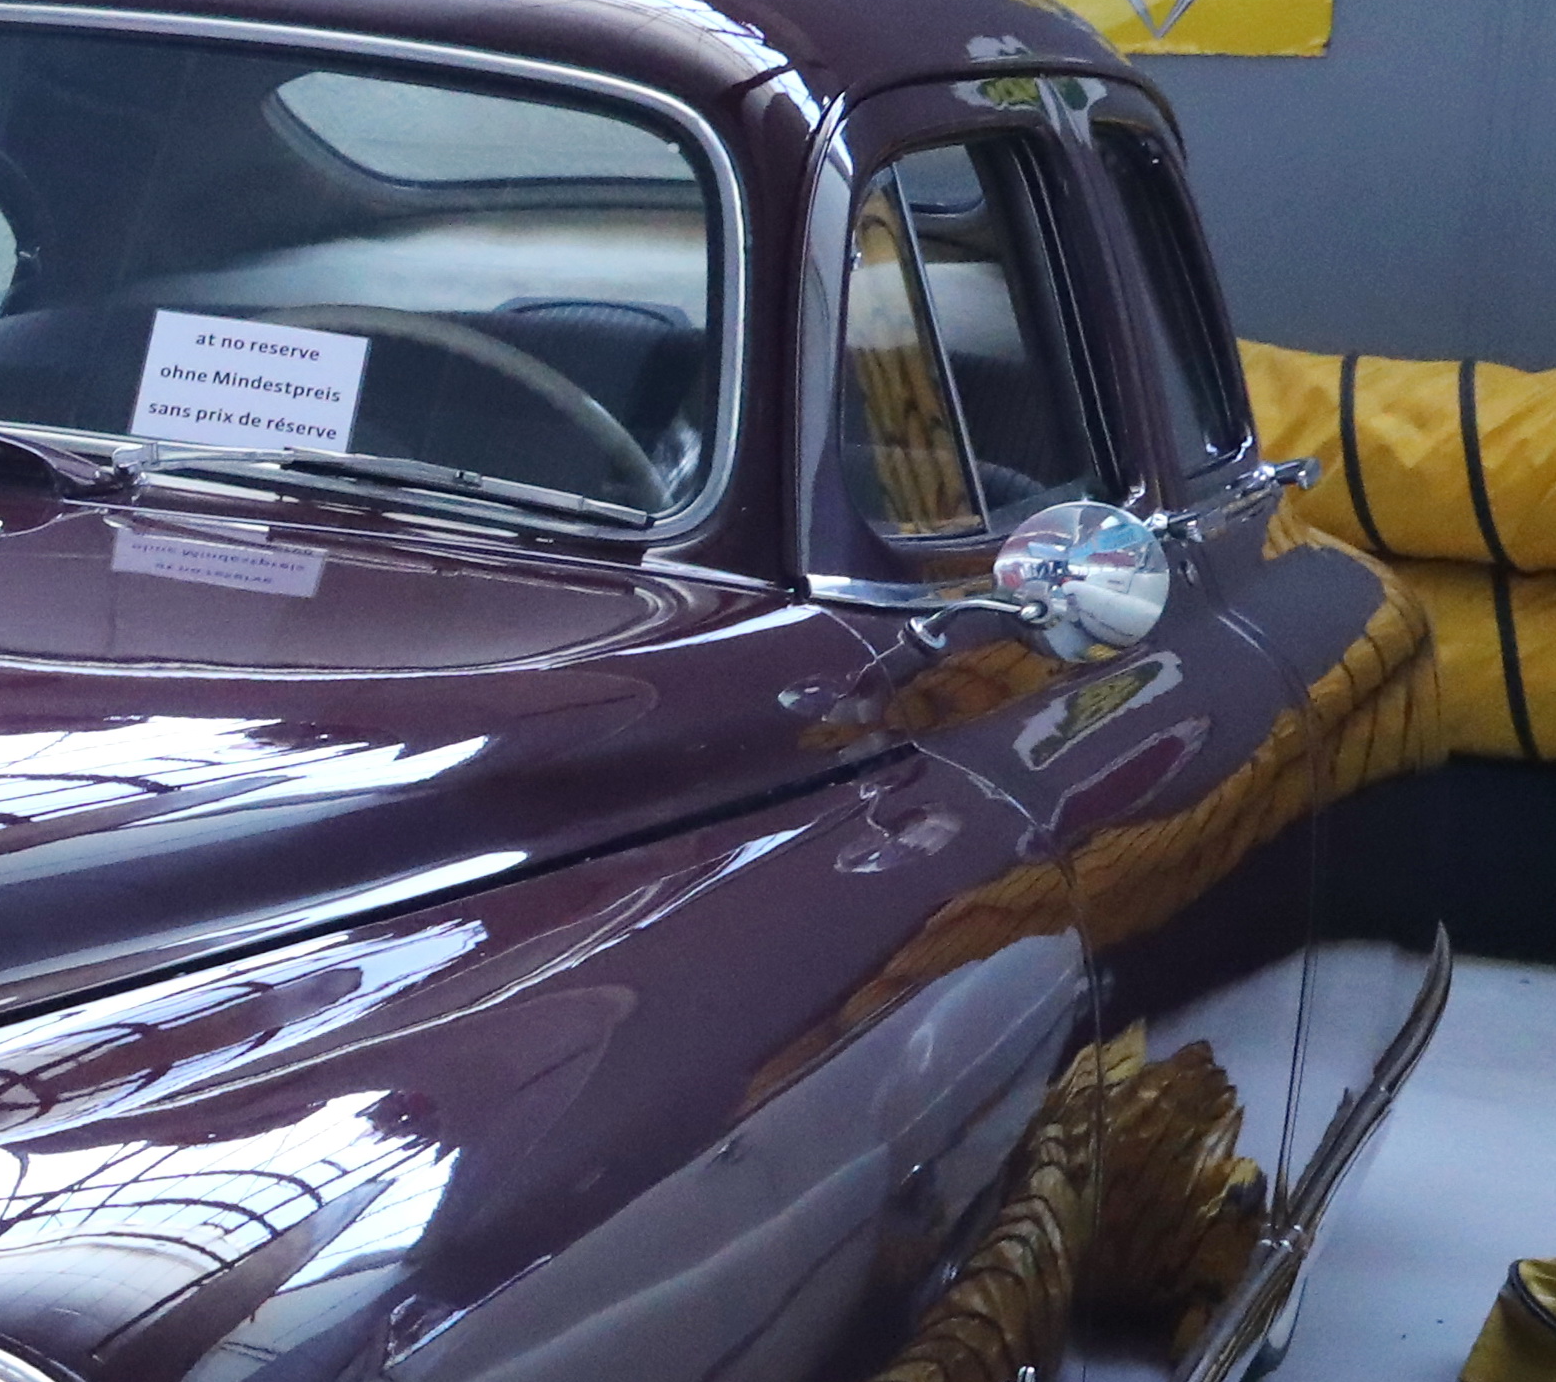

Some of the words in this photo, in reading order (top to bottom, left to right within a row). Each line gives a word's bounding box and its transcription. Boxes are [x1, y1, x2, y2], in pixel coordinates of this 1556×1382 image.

[195, 332, 215, 347] at
[221, 338, 245, 351] no
[250, 340, 321, 362] reserve
[160, 365, 208, 383] ohne
[212, 371, 342, 403] Mindestpreis
[148, 401, 192, 419] sans
[195, 407, 234, 424] prix
[238, 411, 262, 428] de
[266, 417, 338, 441] réserve
